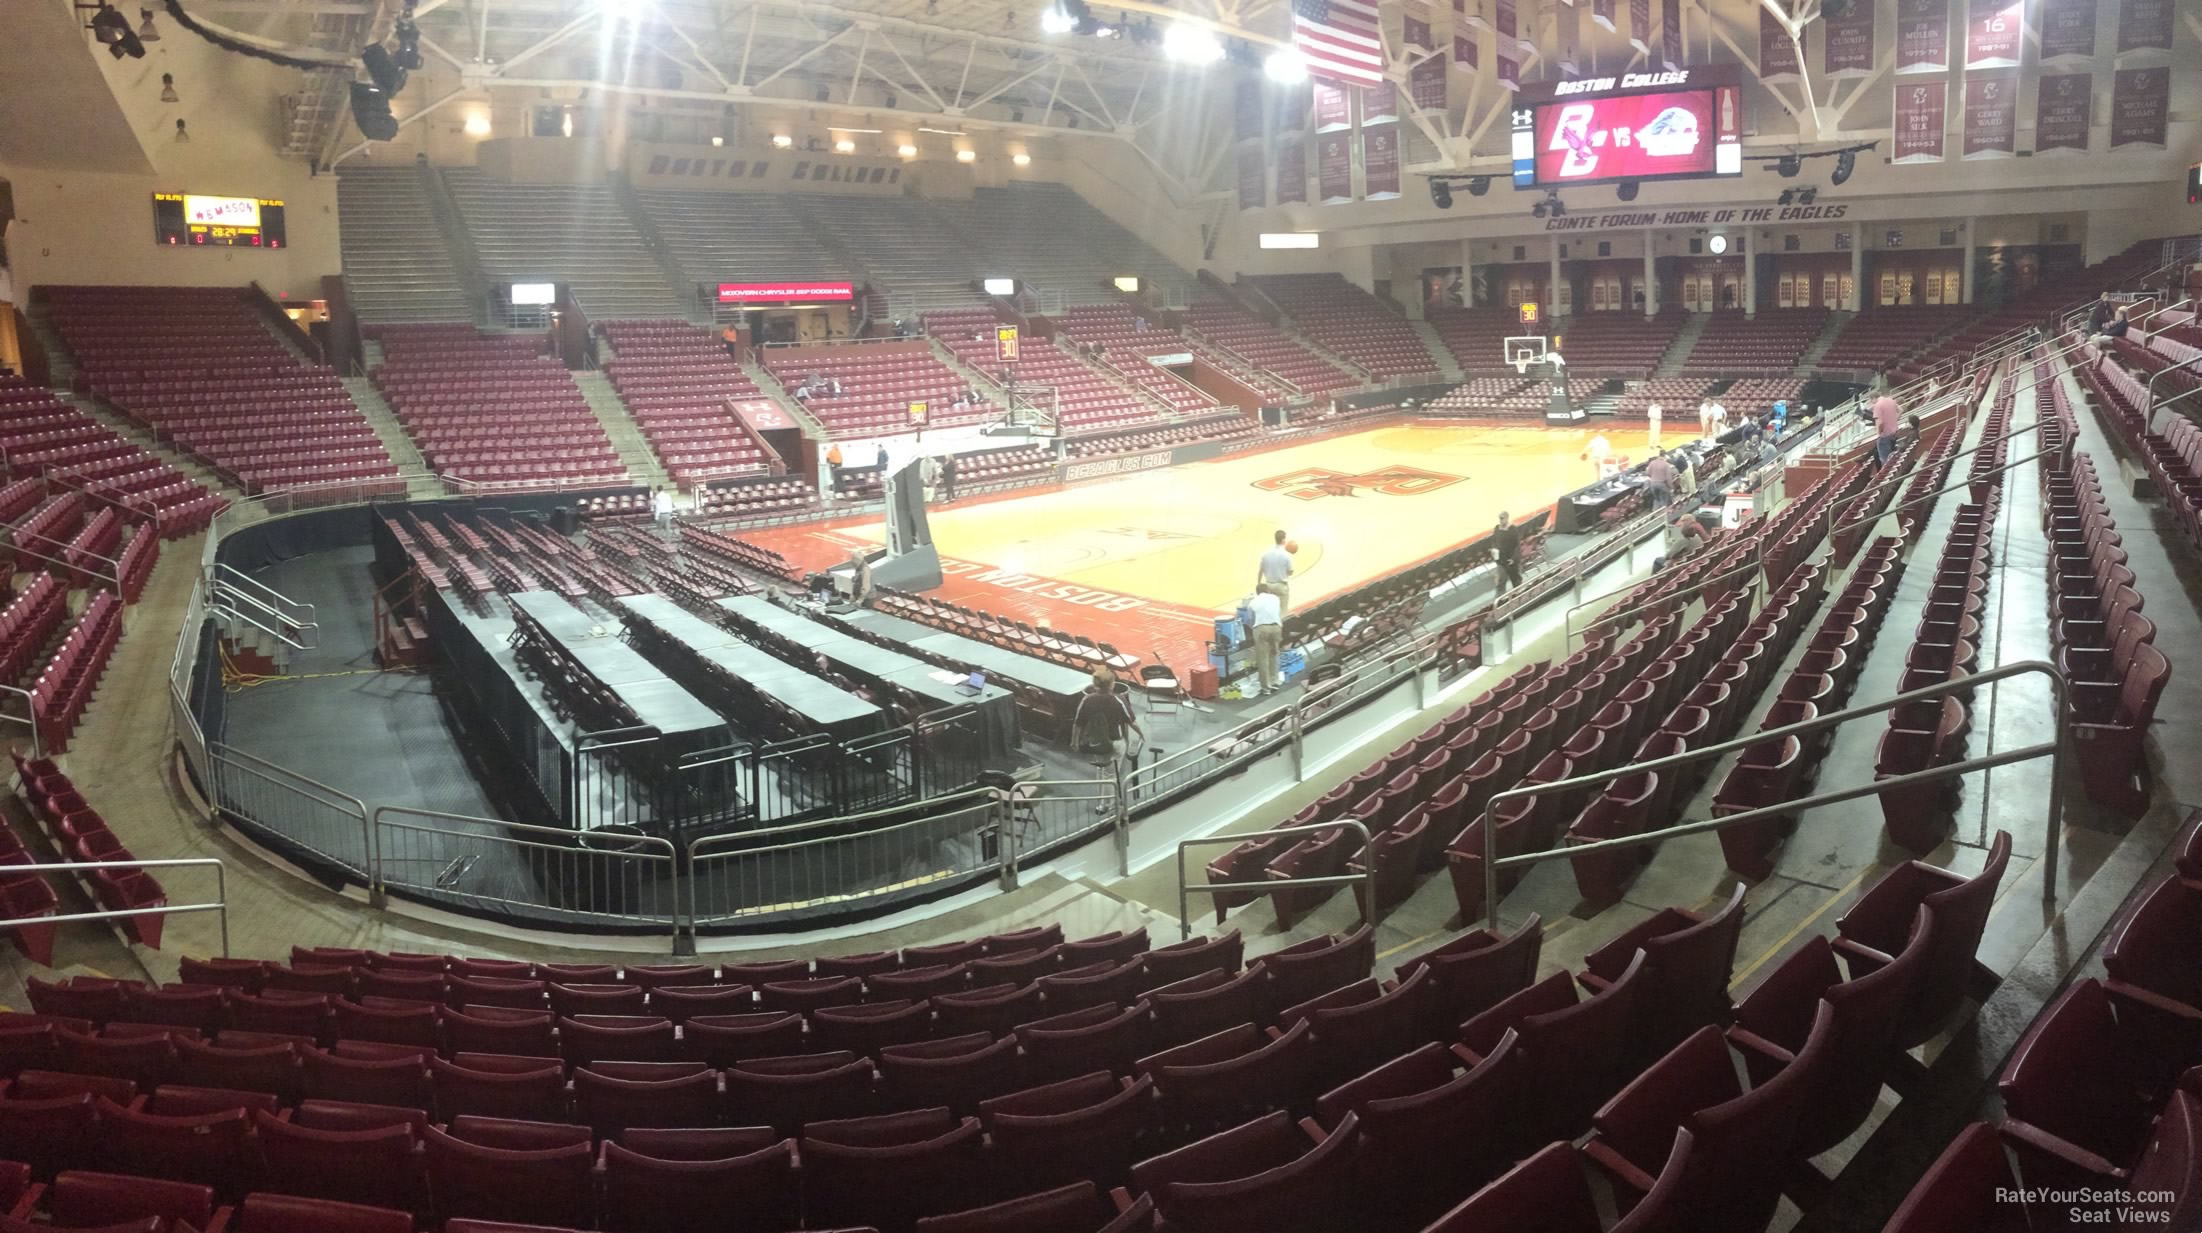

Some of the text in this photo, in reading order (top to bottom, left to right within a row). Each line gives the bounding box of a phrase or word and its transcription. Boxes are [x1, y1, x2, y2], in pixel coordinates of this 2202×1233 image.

[1984, 18, 2005, 32] 16
[1554, 70, 1689, 96] BOSTON COLLEGE
[1545, 205, 1848, 231] CONTE FORUM HOME OF THE EAGLES
[1001, 340, 1016, 357] 30
[964, 568, 1149, 612] BOSTON
